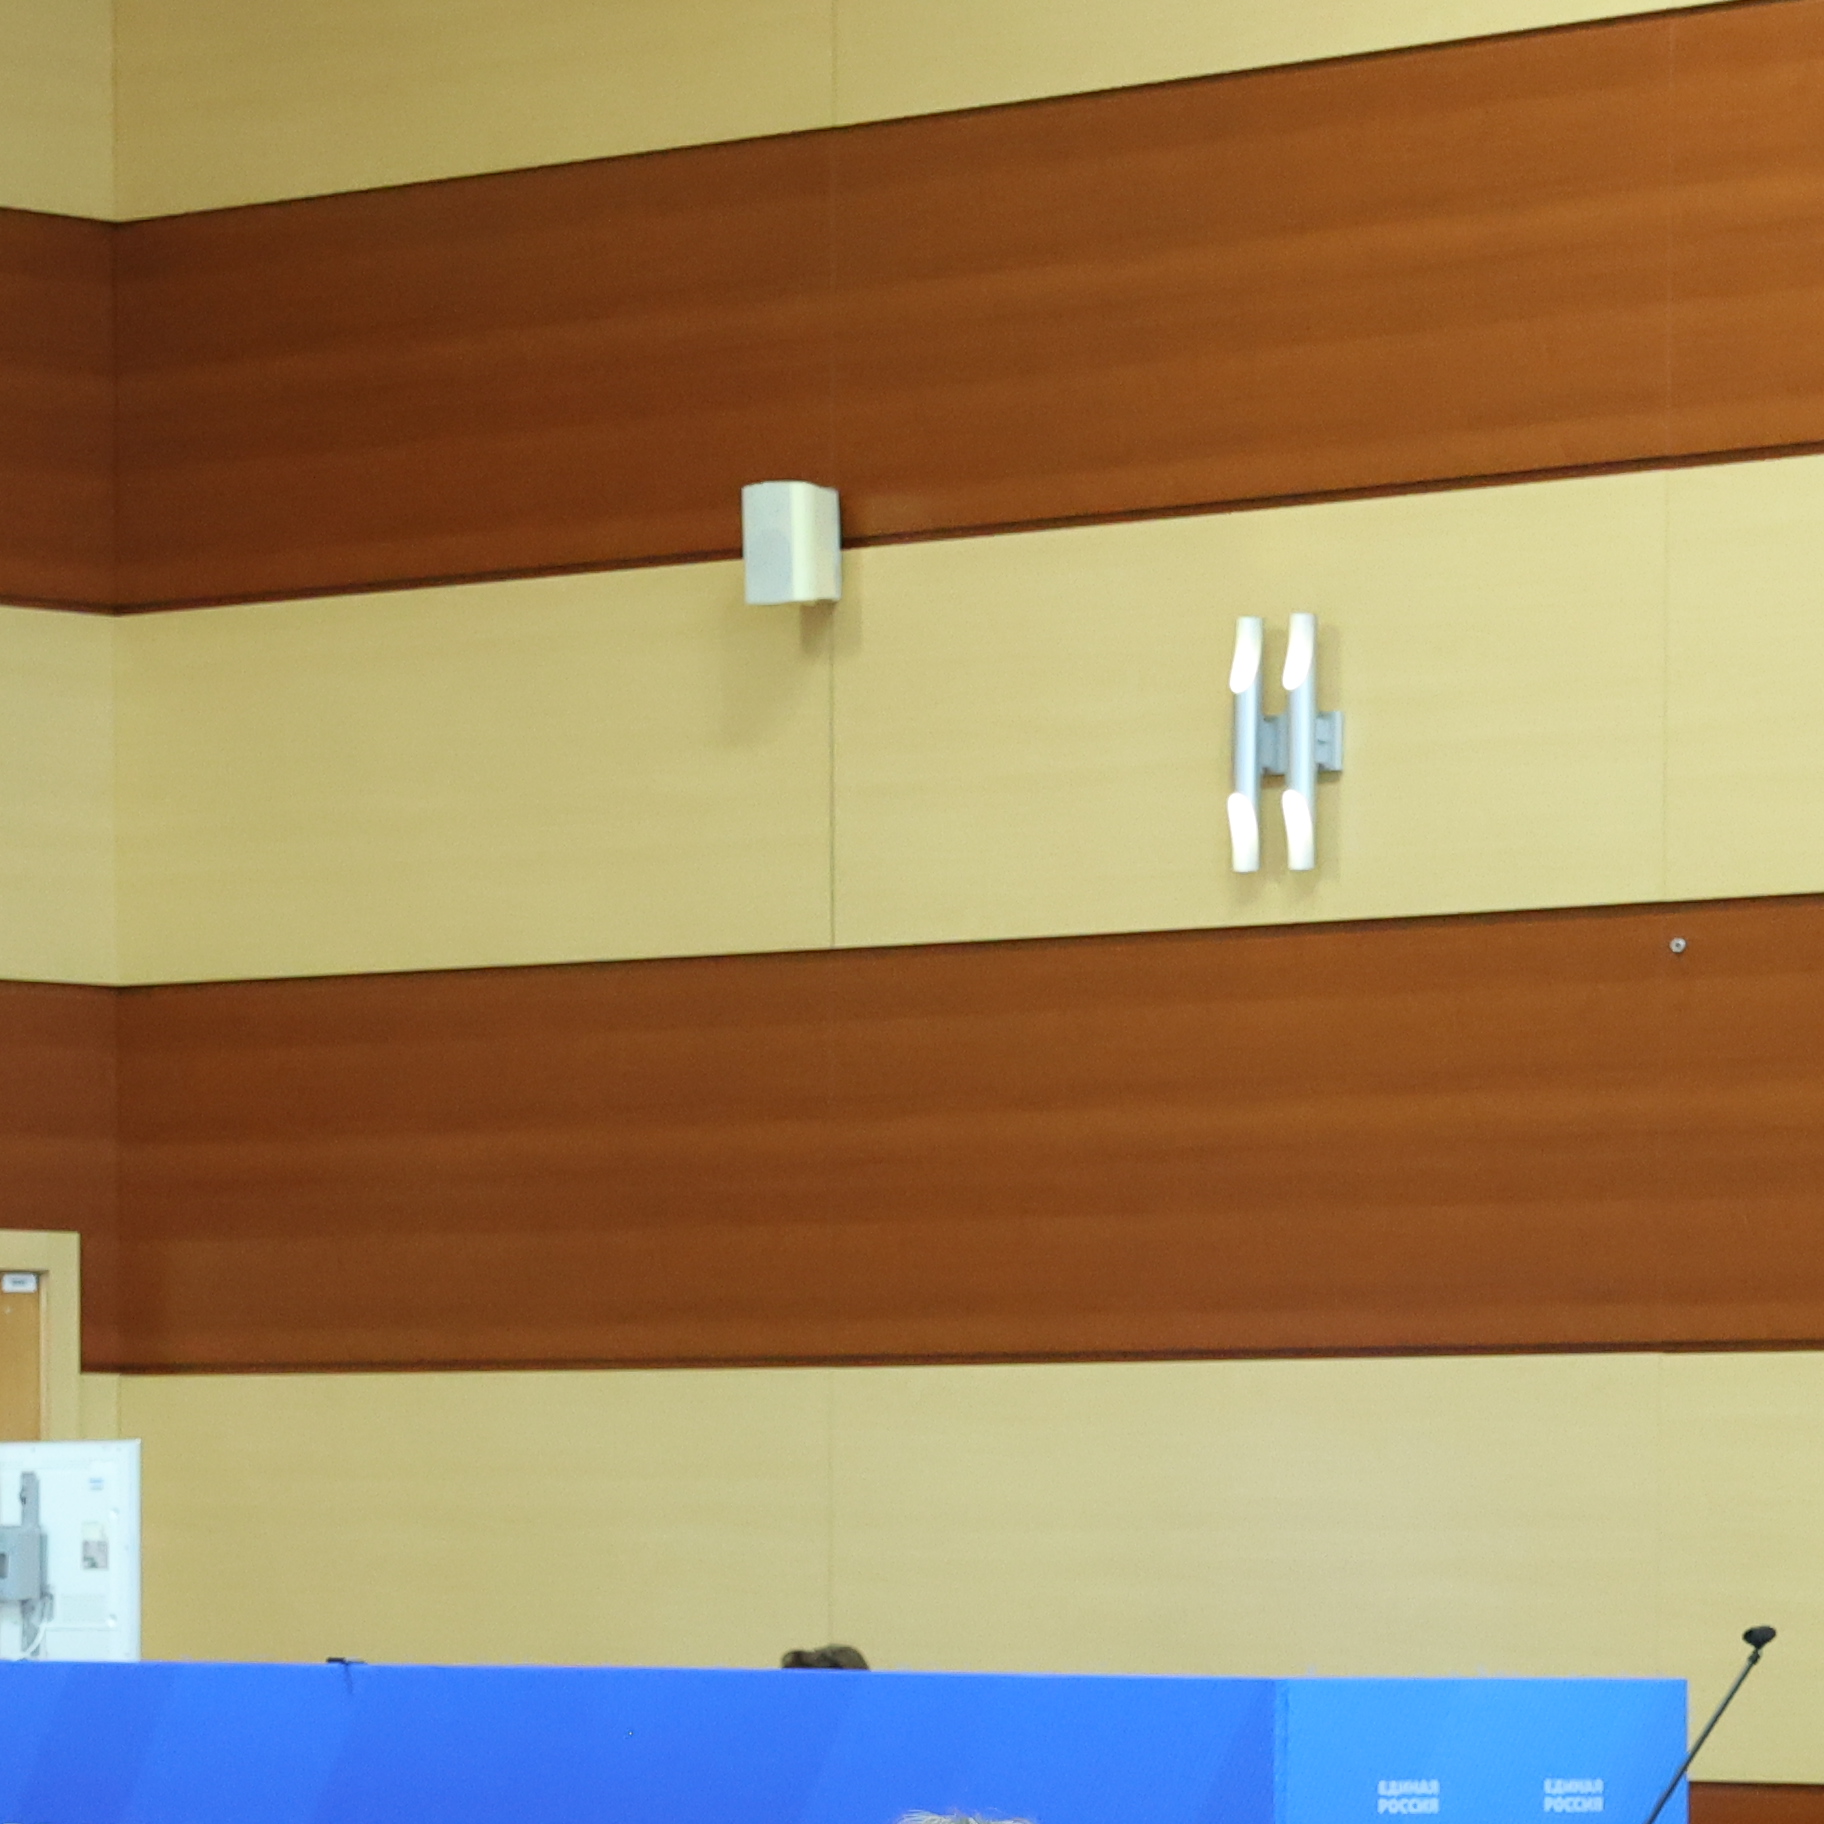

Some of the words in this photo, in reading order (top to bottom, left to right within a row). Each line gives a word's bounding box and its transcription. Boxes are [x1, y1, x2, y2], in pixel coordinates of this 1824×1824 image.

[1378, 1778, 1440, 1796] ЕДИНАЯ
[1543, 1778, 1604, 1795] ЕДИНАЯ
[1378, 1797, 1440, 1814] РОССИЯ
[1543, 1796, 1604, 1812] РОССИЯ
